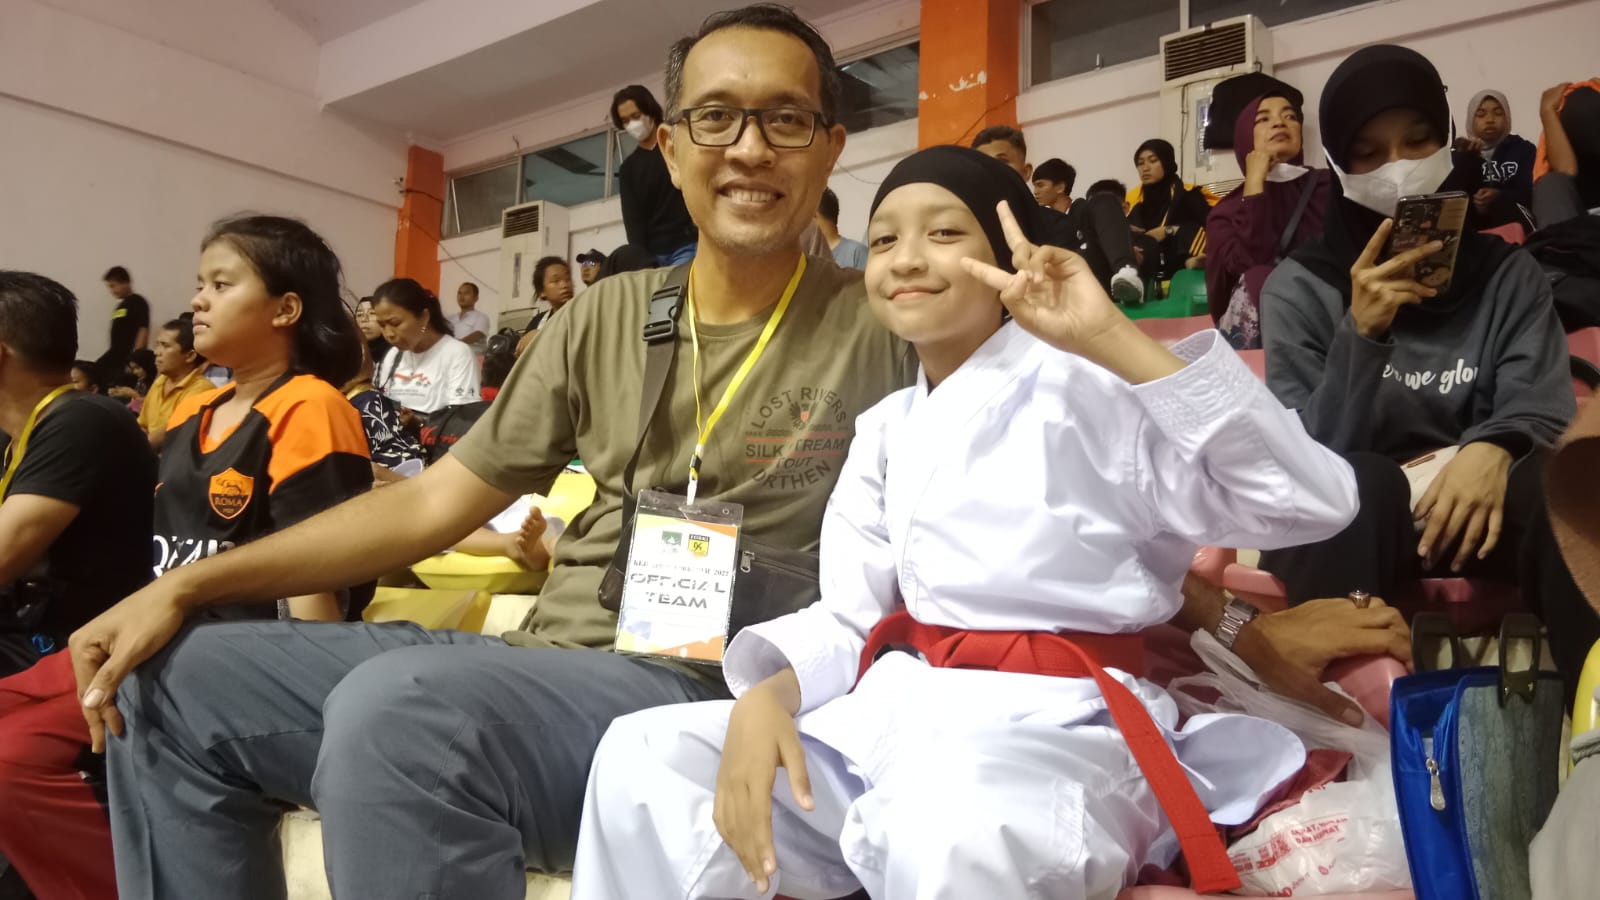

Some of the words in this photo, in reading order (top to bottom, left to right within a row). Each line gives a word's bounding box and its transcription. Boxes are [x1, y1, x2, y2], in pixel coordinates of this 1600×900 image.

[1482, 160, 1519, 181] AP
[1405, 370, 1436, 390] we
[751, 389, 793, 430] LOST
[800, 387, 847, 423] RIVERS
[745, 443, 784, 458] SILK
[789, 438, 845, 452] TREAM
[214, 496, 244, 506] ROMA
[645, 591, 708, 609] TEAM
